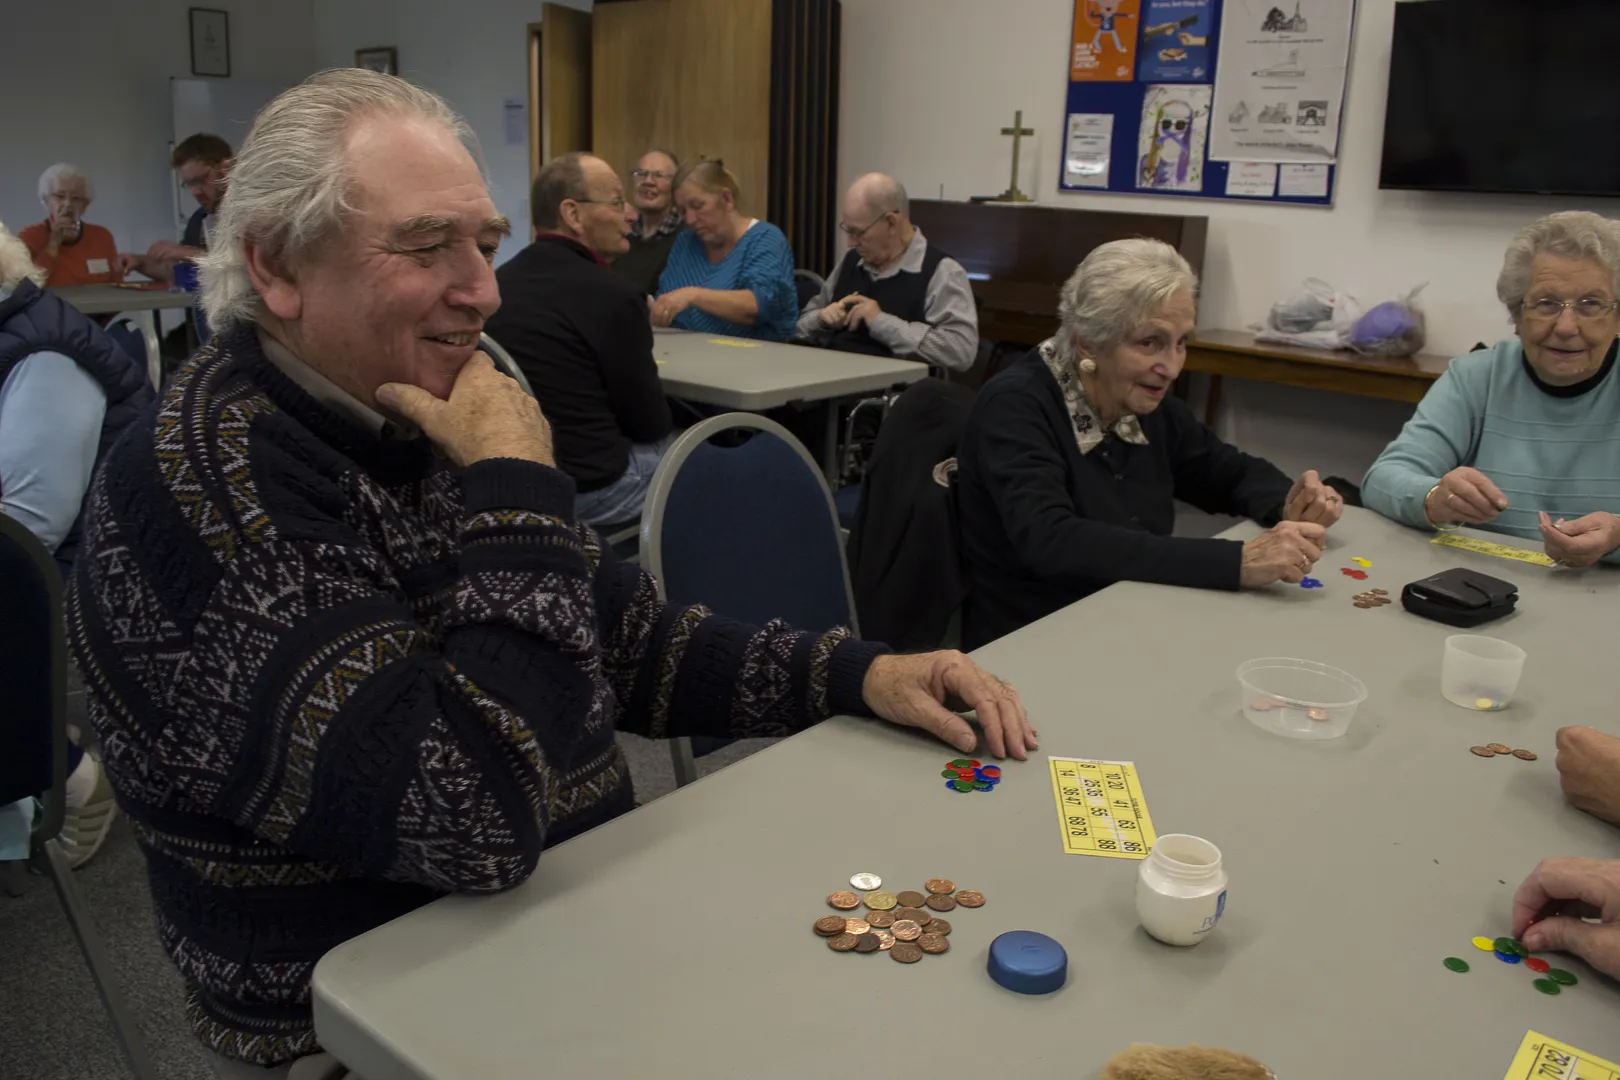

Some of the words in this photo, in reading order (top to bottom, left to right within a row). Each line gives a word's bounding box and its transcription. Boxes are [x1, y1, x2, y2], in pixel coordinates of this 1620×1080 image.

[1084, 779, 1101, 788] 25
[1107, 781, 1125, 790] 20
[1063, 787, 1080, 796] 36
[1086, 788, 1103, 797] 35
[1065, 797, 1082, 806] 47
[1113, 800, 1130, 808] 41
[1090, 807, 1108, 817] 55
[1068, 816, 1086, 826] 68
[1118, 820, 1136, 830] 63
[1070, 827, 1088, 836] 78
[1098, 839, 1117, 850] 88
[1123, 841, 1142, 852] 86
[1544, 1049, 1571, 1066] 82
[1538, 1063, 1565, 1080] 70
